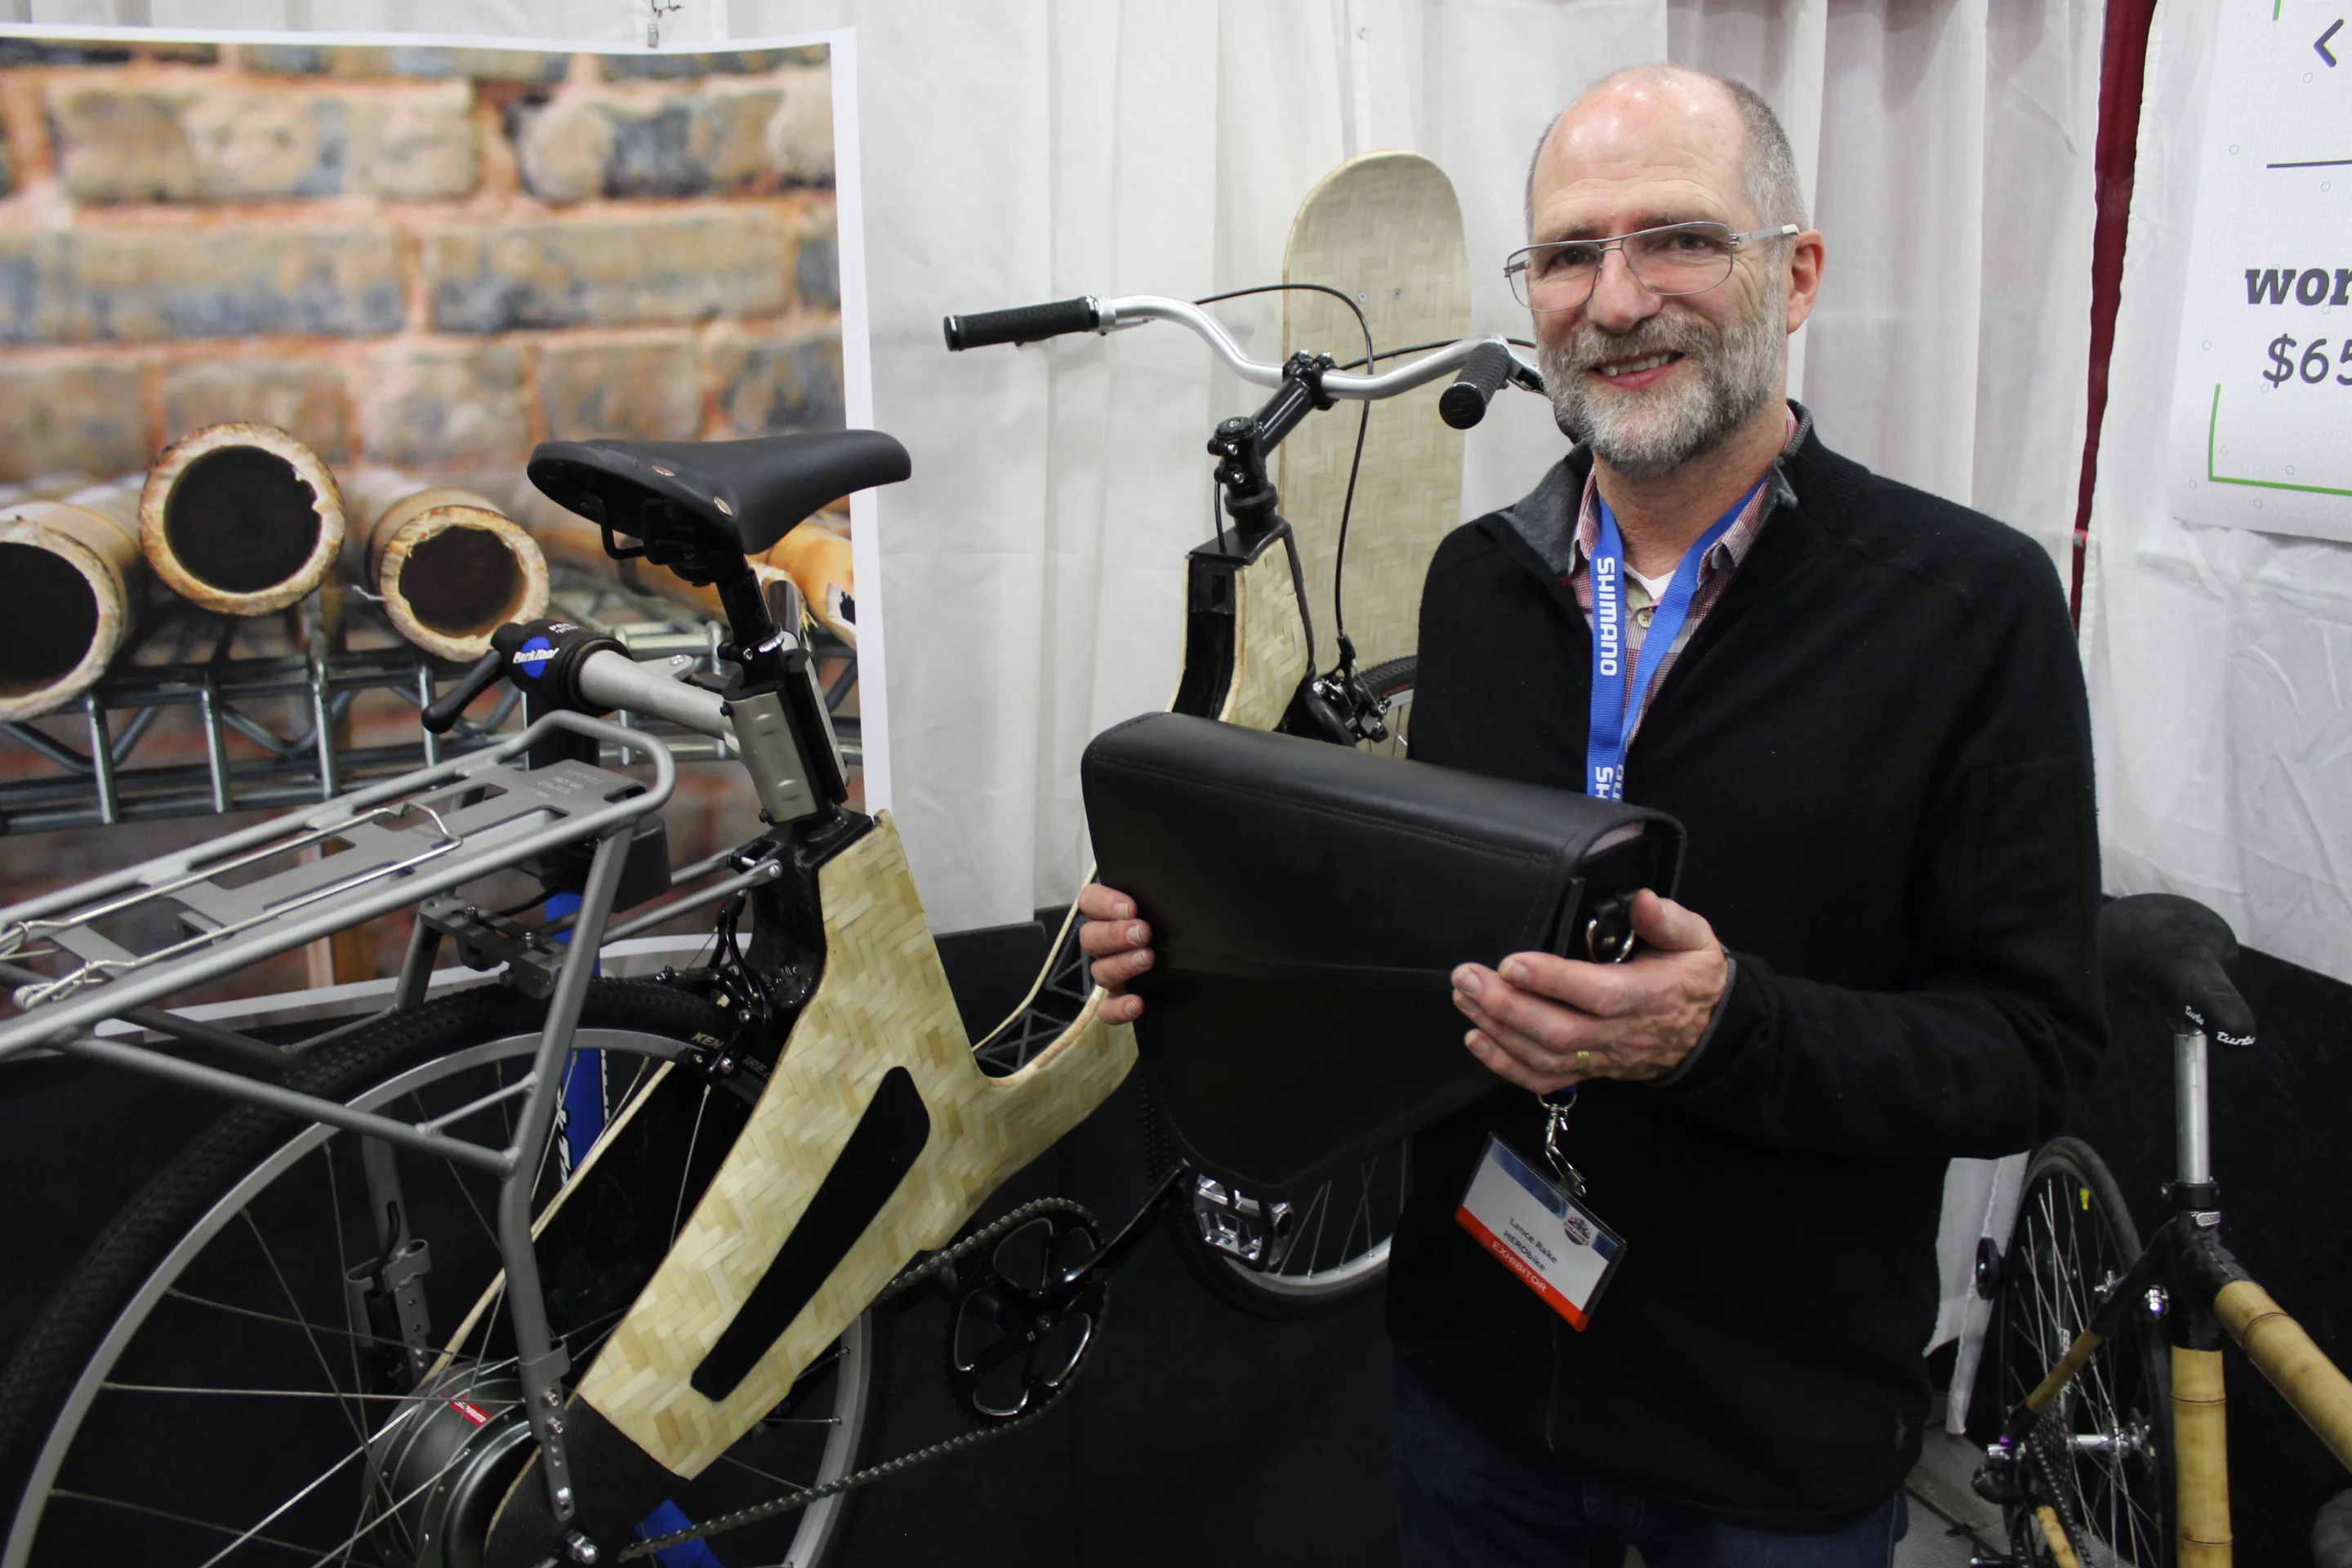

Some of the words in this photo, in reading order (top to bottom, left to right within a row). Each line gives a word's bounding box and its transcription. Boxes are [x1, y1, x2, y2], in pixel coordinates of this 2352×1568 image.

[1597, 557, 1618, 676] SHIMANO
[690, 1031, 725, 1050] KEN
[1510, 1217, 1535, 1244] Lance
[1535, 1241, 1558, 1264] Rake
[1492, 1241, 1547, 1293] EXHIBITOR
